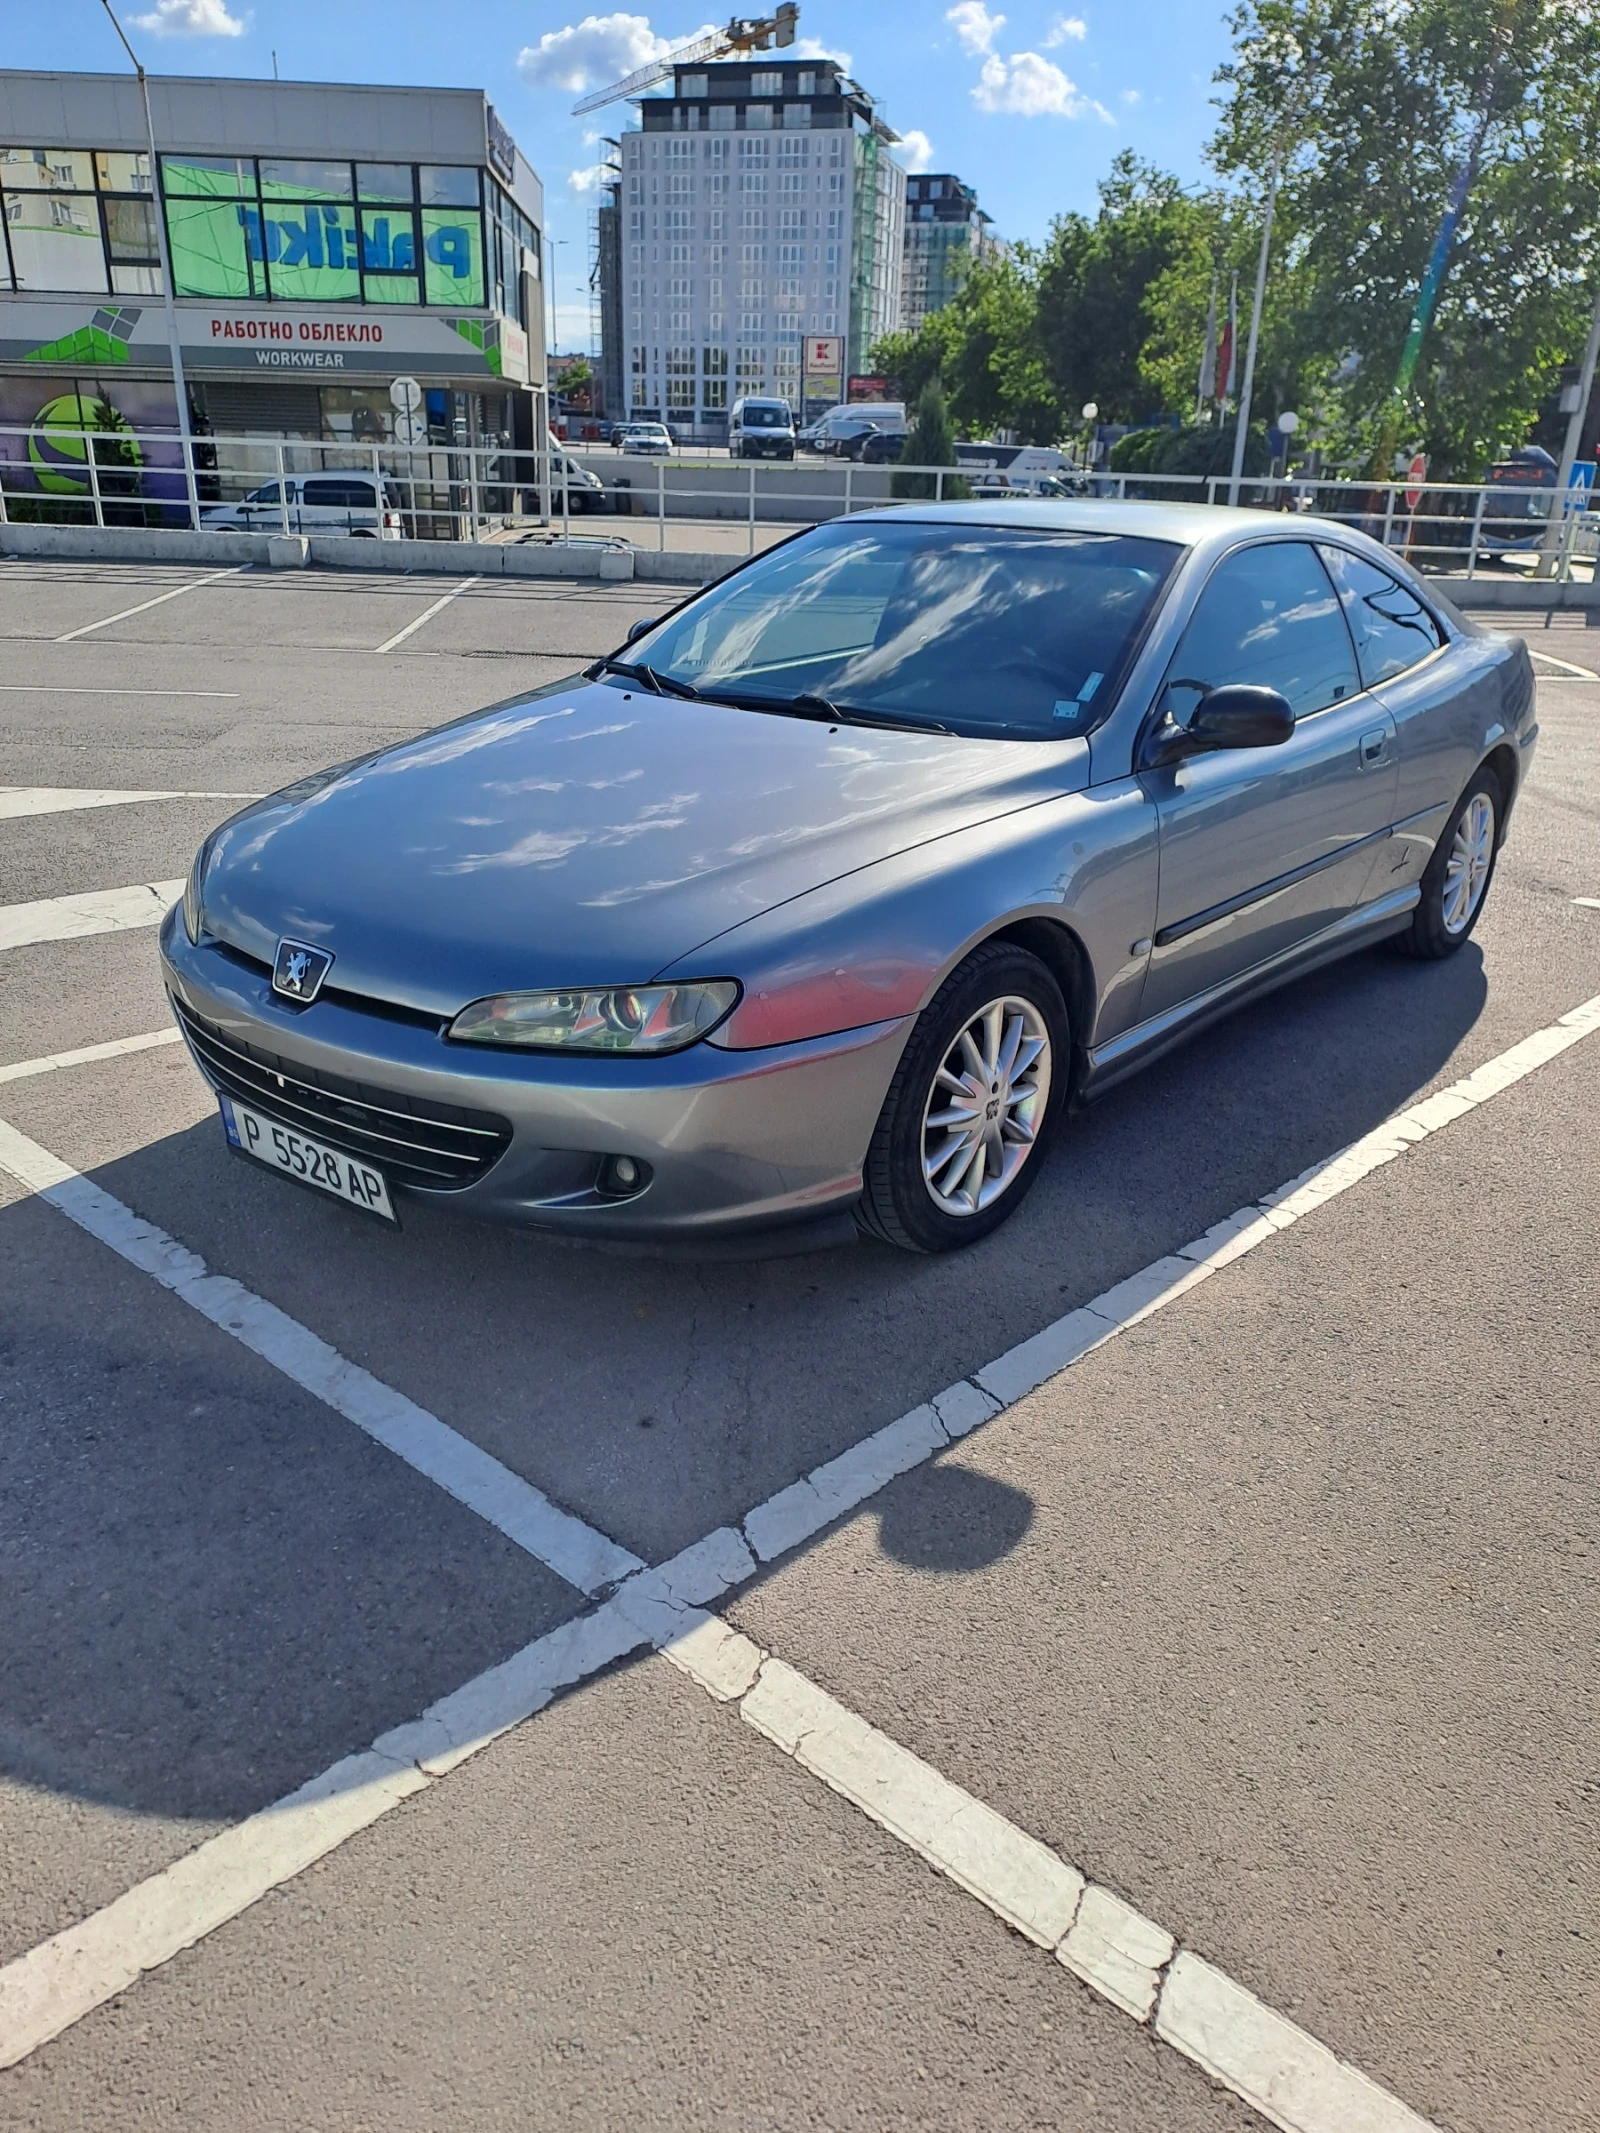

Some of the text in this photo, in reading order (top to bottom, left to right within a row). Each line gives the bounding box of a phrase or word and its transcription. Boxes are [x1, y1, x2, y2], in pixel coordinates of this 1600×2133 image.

[211, 319, 384, 343] РАБОТНО ОБЛЕКЛО
[256, 350, 345, 368] WORKWEAR
[243, 1112, 382, 1207] P 5528 AP
